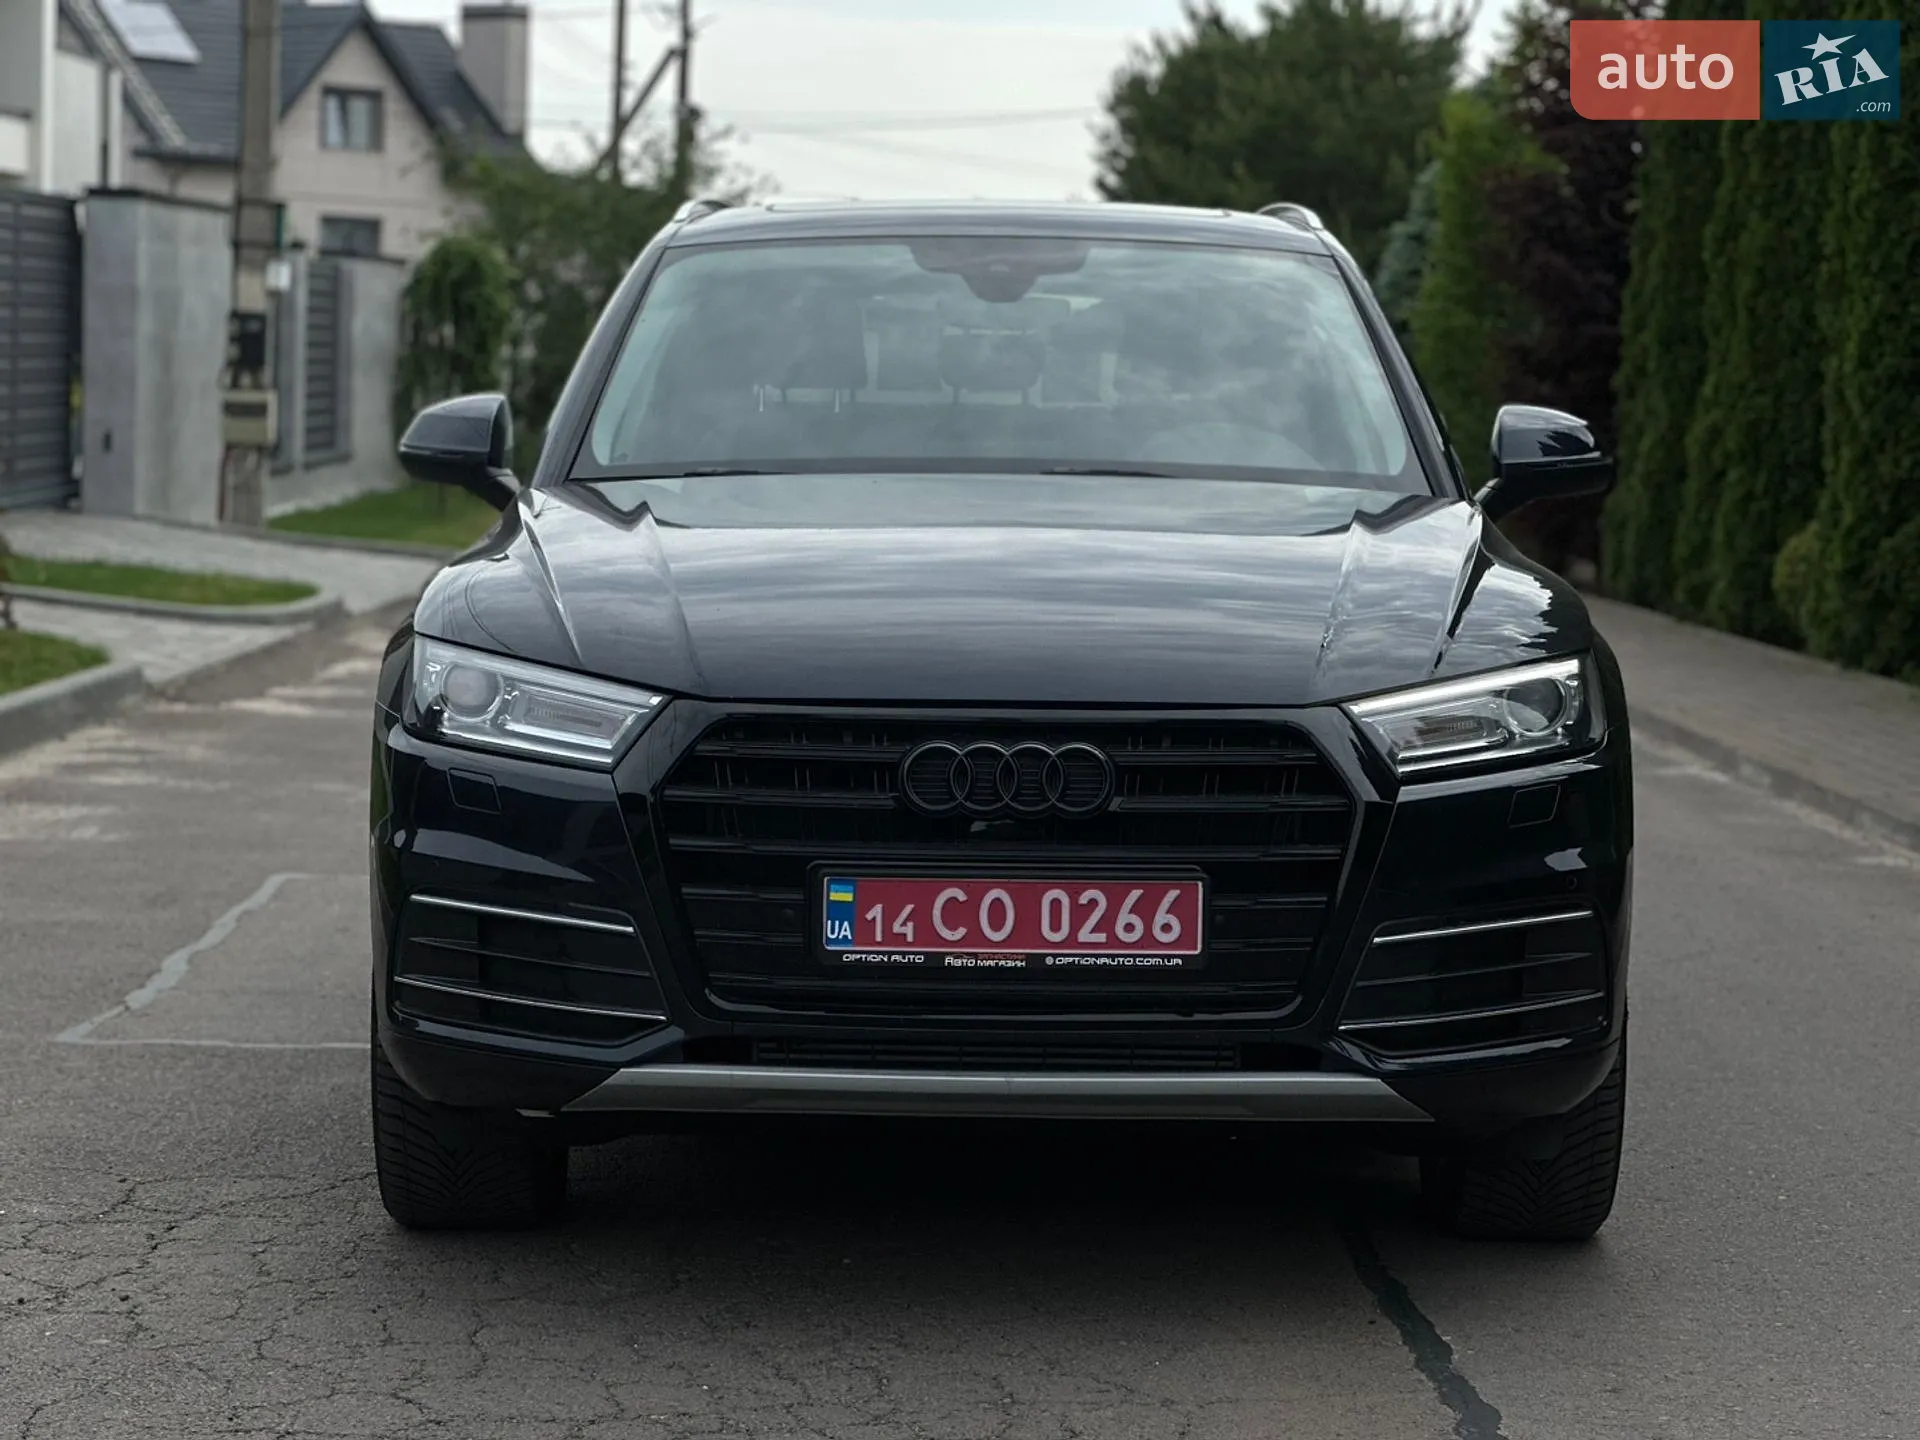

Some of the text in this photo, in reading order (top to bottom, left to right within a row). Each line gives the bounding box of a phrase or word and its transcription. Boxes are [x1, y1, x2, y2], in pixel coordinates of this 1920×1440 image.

[864, 887, 1182, 944] 14 CO 0266
[826, 919, 853, 940] UA
[890, 954, 925, 963] AUTO
